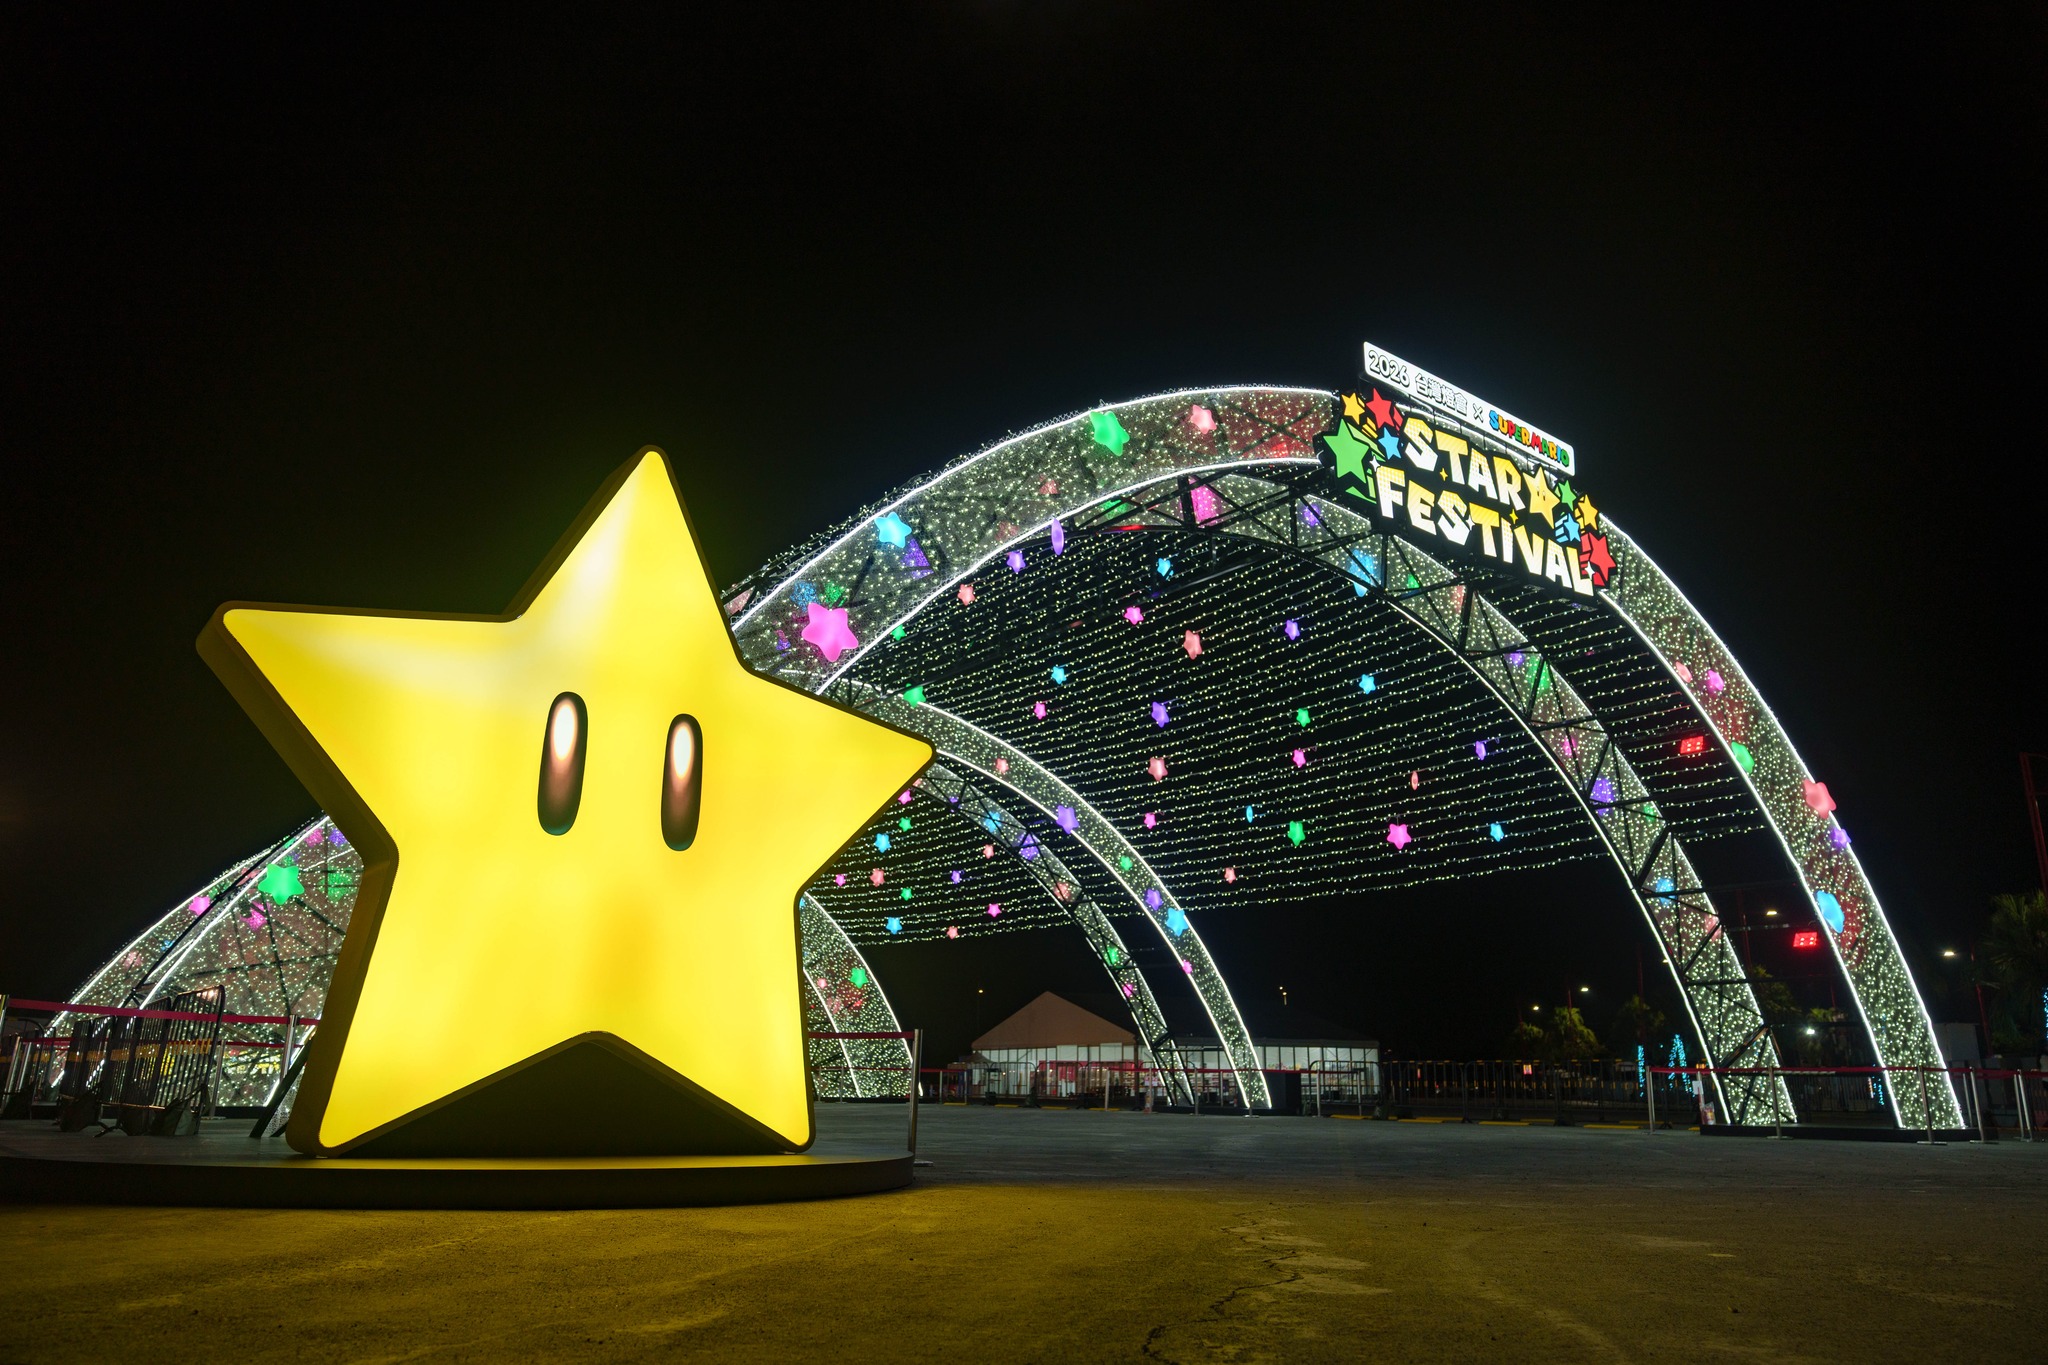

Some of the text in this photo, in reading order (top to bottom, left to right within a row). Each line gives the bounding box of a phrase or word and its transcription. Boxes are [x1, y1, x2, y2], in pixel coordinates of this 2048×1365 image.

[1368, 350, 1410, 388] 2026
[1415, 372, 1468, 417] 台灣燈會
[1489, 410, 1531, 446] SUPER
[1530, 432, 1570, 468] MARIO
[1403, 417, 1526, 511] STAR
[1376, 465, 1594, 597] FESTIVAL
